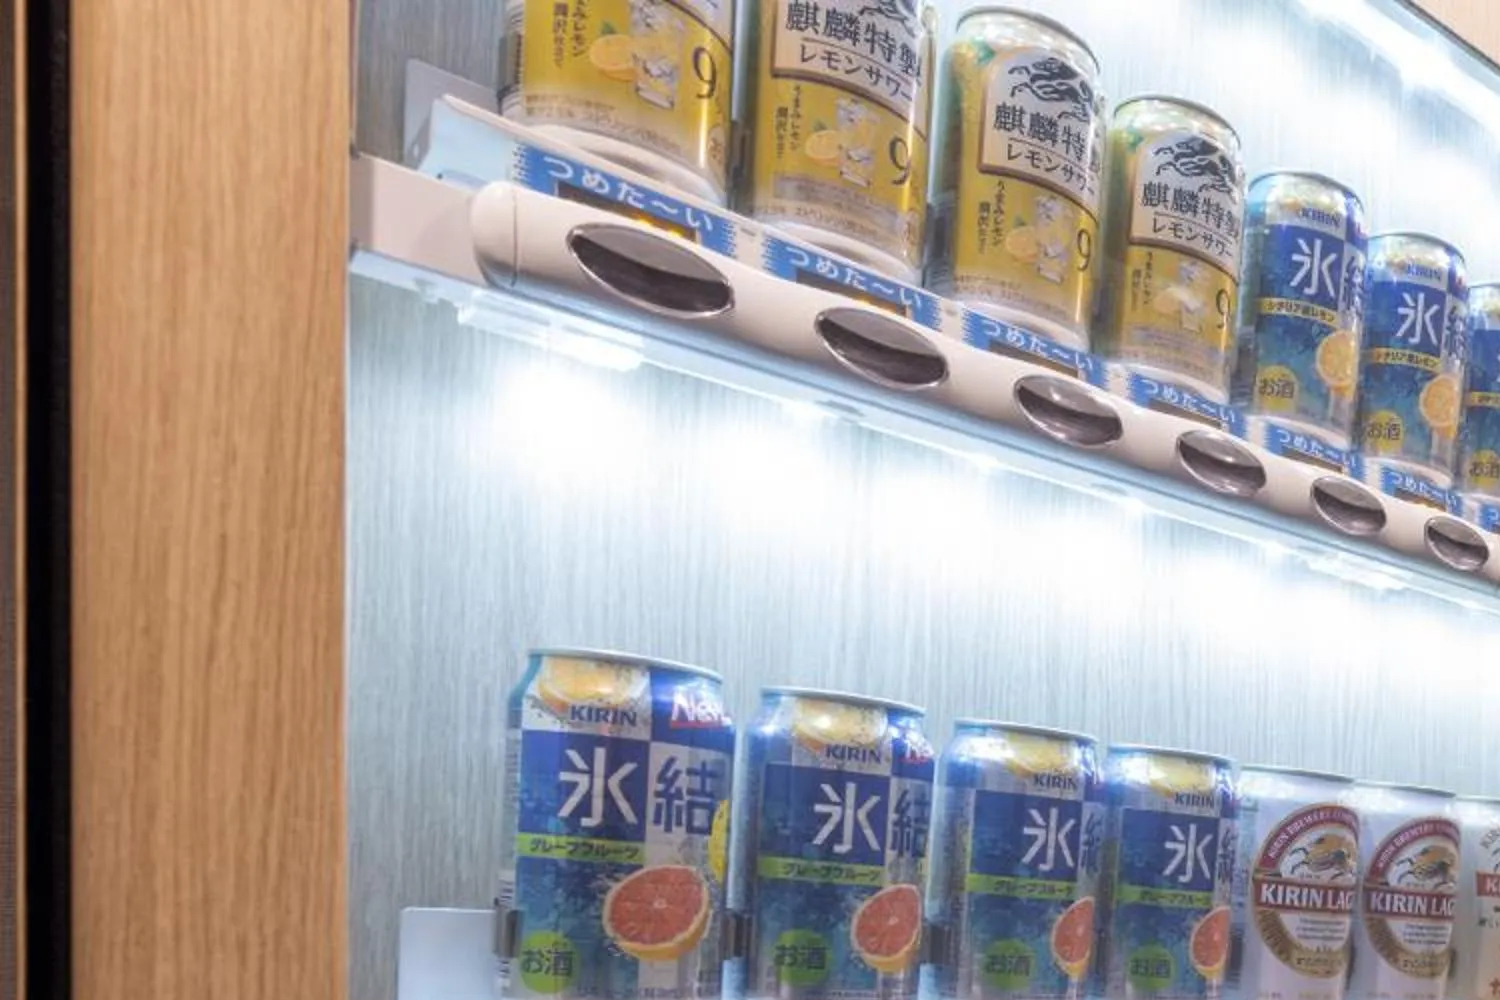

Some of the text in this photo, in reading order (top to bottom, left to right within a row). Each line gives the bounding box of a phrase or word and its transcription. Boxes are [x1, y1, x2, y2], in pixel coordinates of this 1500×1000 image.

[693, 46, 717, 99] 9
[800, 44, 912, 101] レモンサワー
[889, 137, 911, 185] 9
[1077, 229, 1090, 271] 9
[1216, 288, 1231, 329] 9
[570, 704, 637, 727] KIRIN
[825, 744, 881, 765] KIRIN
[558, 747, 716, 836] 氷結
[1033, 774, 1078, 790] KIRIN
[1174, 792, 1215, 809] KIRIN
[1261, 883, 1323, 909] KIRIN
[1370, 891, 1427, 916] KIRIN
[520, 946, 575, 979] お酒
[774, 944, 828, 971] お酒
